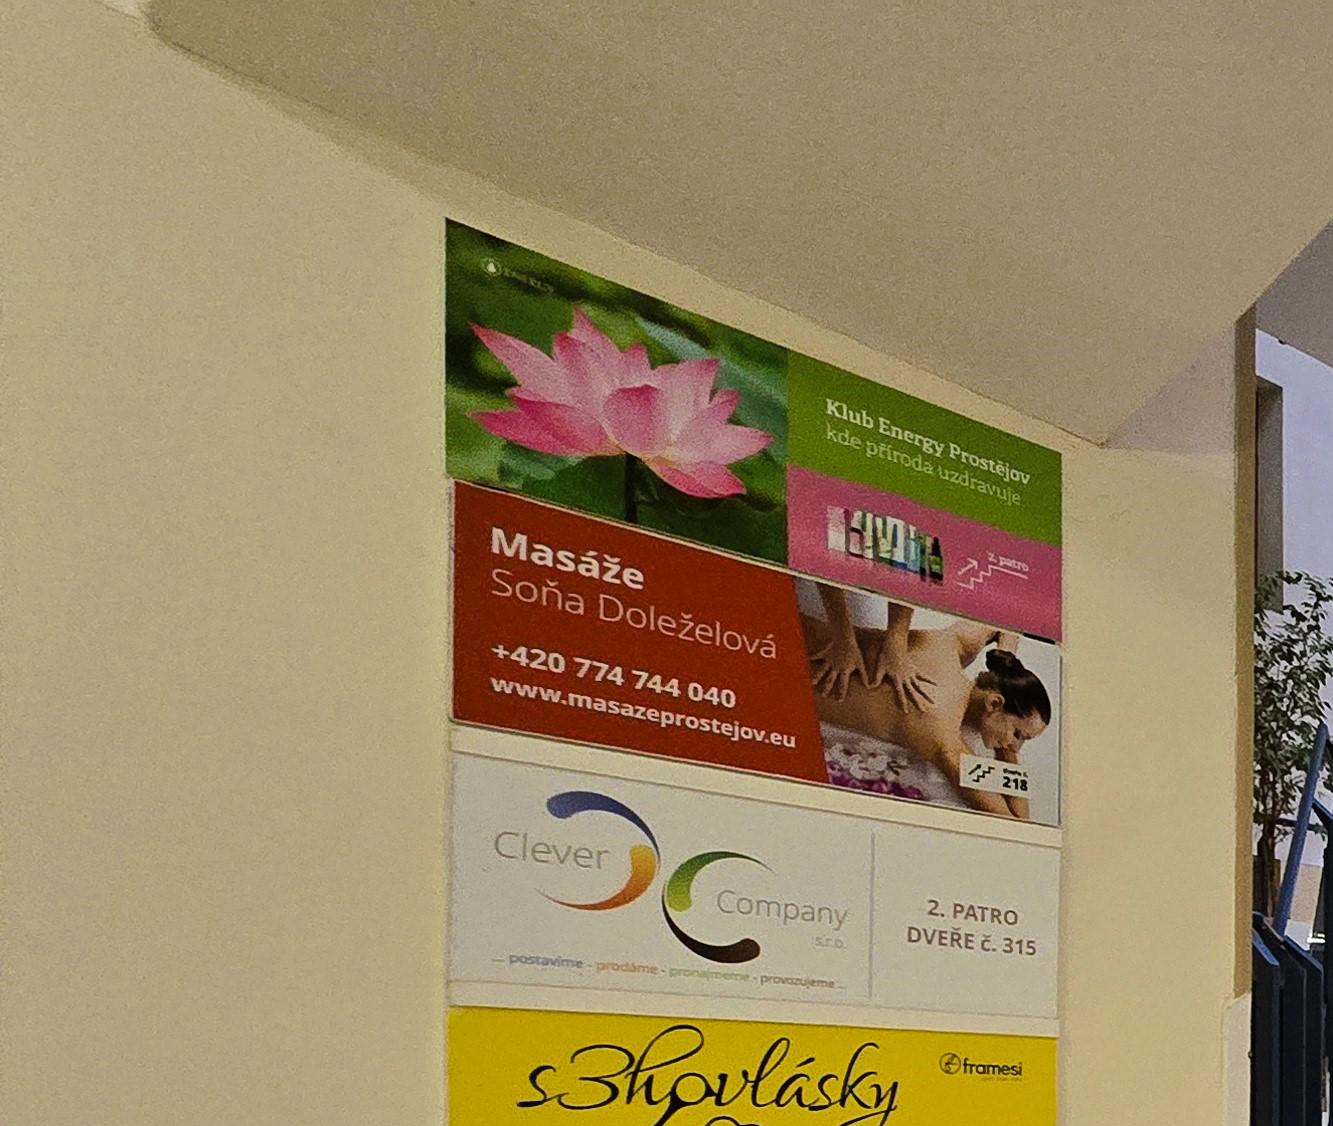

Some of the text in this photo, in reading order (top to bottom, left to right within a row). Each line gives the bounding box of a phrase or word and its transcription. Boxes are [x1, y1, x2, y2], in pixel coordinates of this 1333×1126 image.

[826, 398, 1031, 485] Klub Energy Prostějov
[826, 420, 1021, 507] kde příroda uzdravuje
[491, 526, 645, 591] Masáže
[998, 556, 1030, 573] patro
[490, 568, 777, 659] Soňa Doleželová
[490, 643, 736, 709] +420 774 744 040
[489, 675, 797, 749] www.masazeprostejov.eu
[1002, 775, 1028, 792] 218
[494, 830, 613, 870] Clever
[716, 889, 849, 931] Company
[927, 899, 1019, 926] 2. PATRO
[906, 926, 1037, 956] DVEŘE č. 315
[963, 1057, 1024, 1077] framesi
